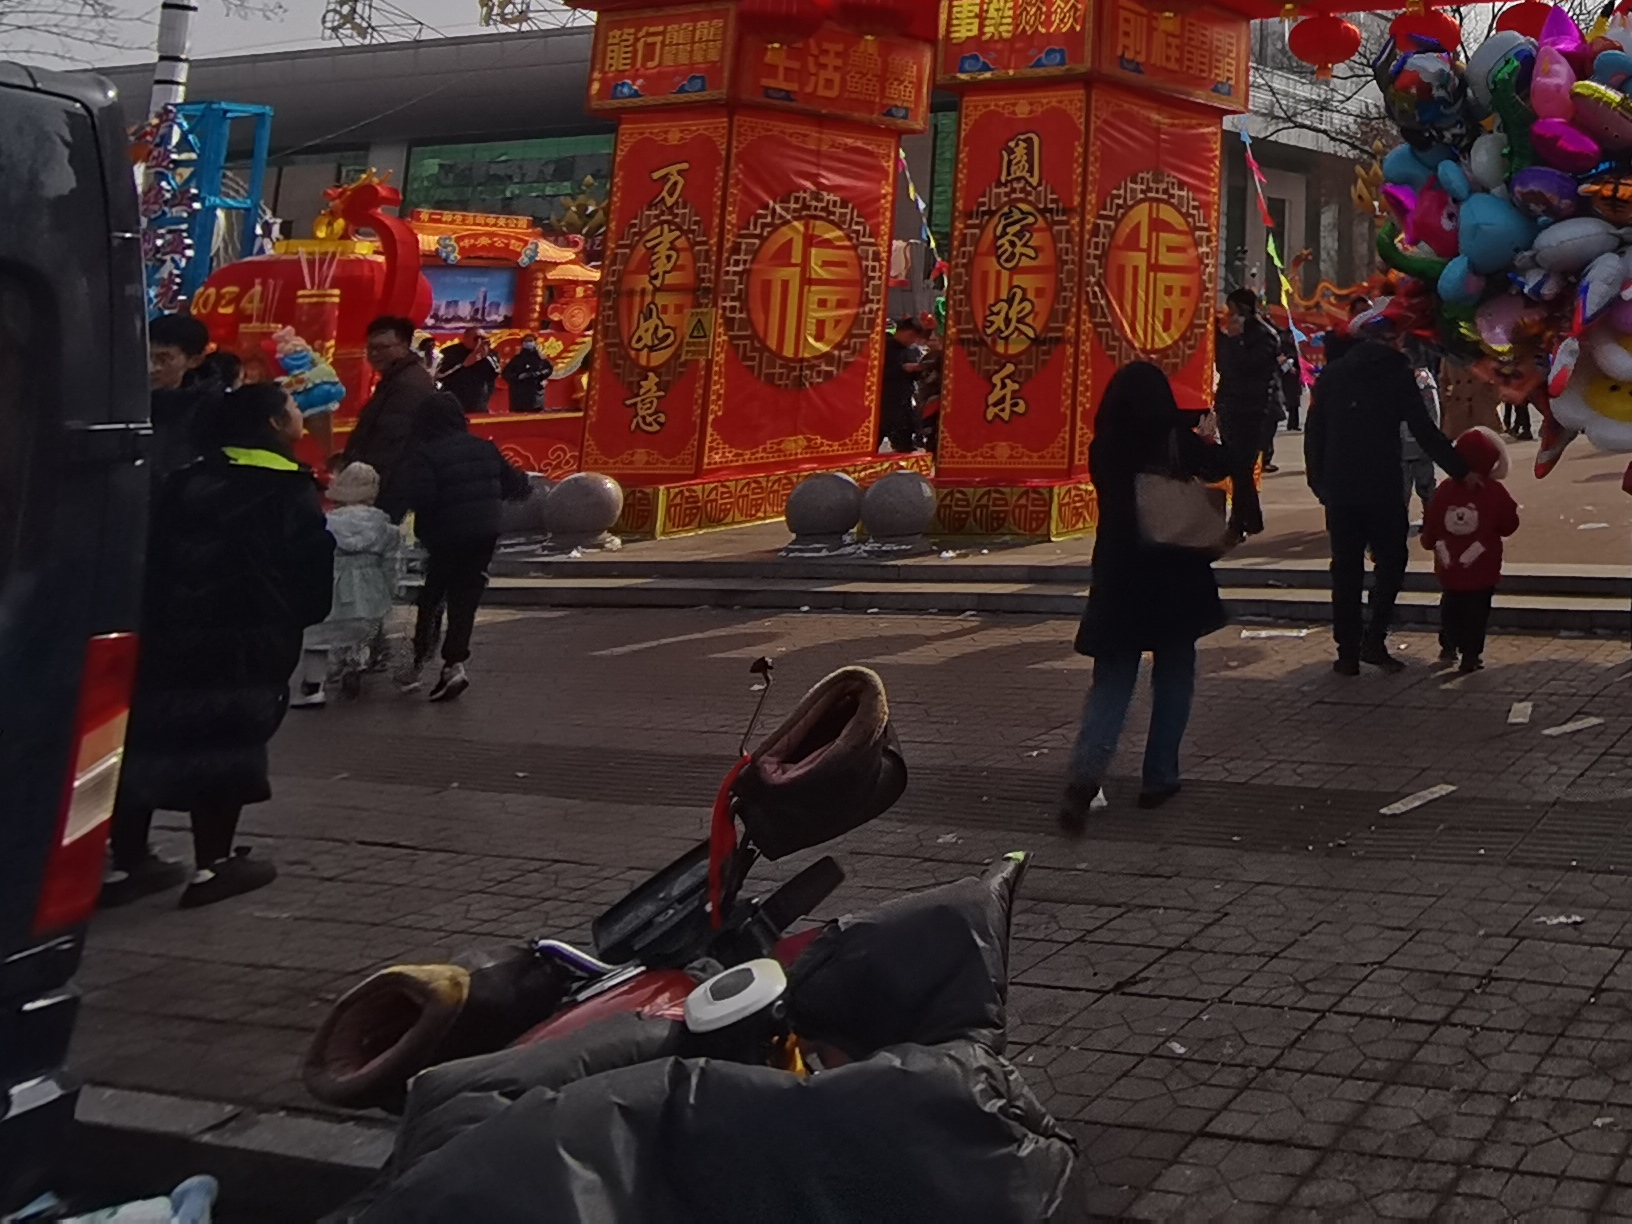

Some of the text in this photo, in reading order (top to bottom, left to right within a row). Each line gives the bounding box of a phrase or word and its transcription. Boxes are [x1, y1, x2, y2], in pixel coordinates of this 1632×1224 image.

[624, 162, 690, 434] 万事如意
[751, 219, 861, 359] 福
[985, 132, 1041, 423] 阖家欢乐
[1107, 201, 1200, 349] 福
